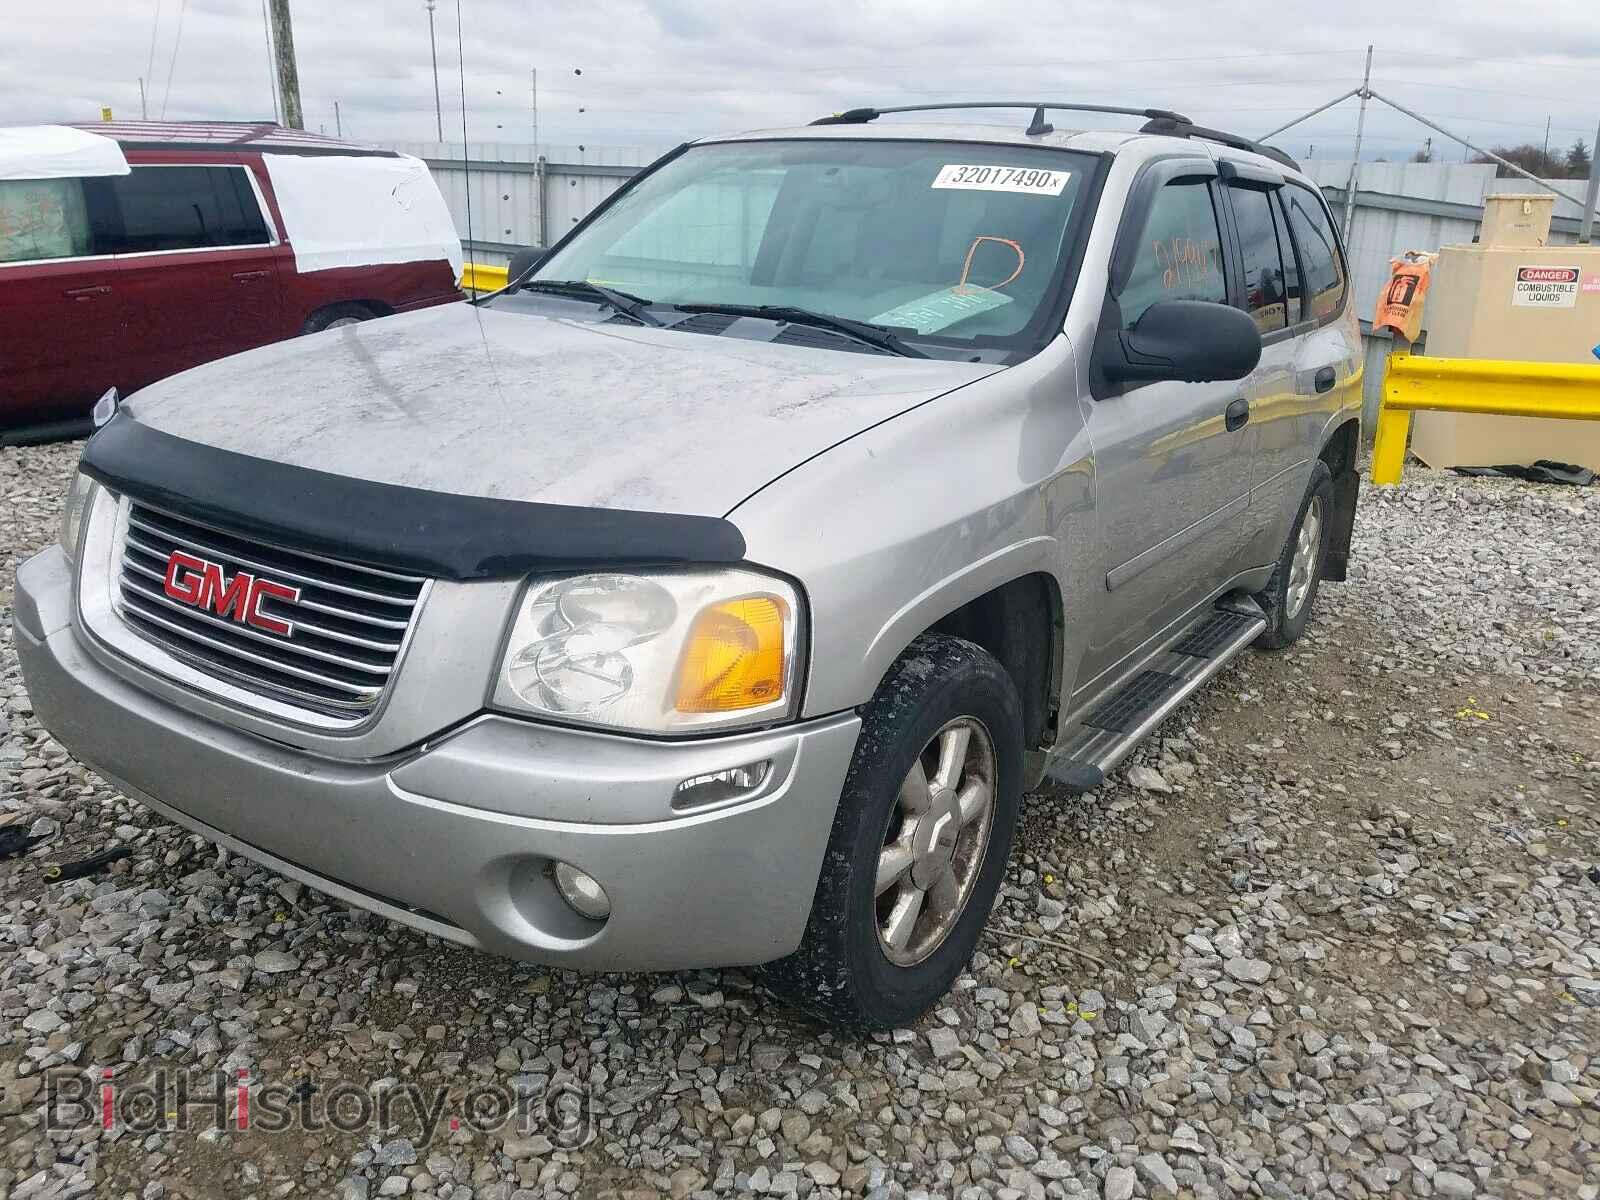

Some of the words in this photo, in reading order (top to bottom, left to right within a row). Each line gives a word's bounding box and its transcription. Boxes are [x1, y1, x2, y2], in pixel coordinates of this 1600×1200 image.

[1526, 271, 1570, 280] DANGER
[1517, 283, 1576, 293] COMBUSTIBLE
[1528, 292, 1561, 302] LIQUIDS
[164, 550, 301, 638] GMC
